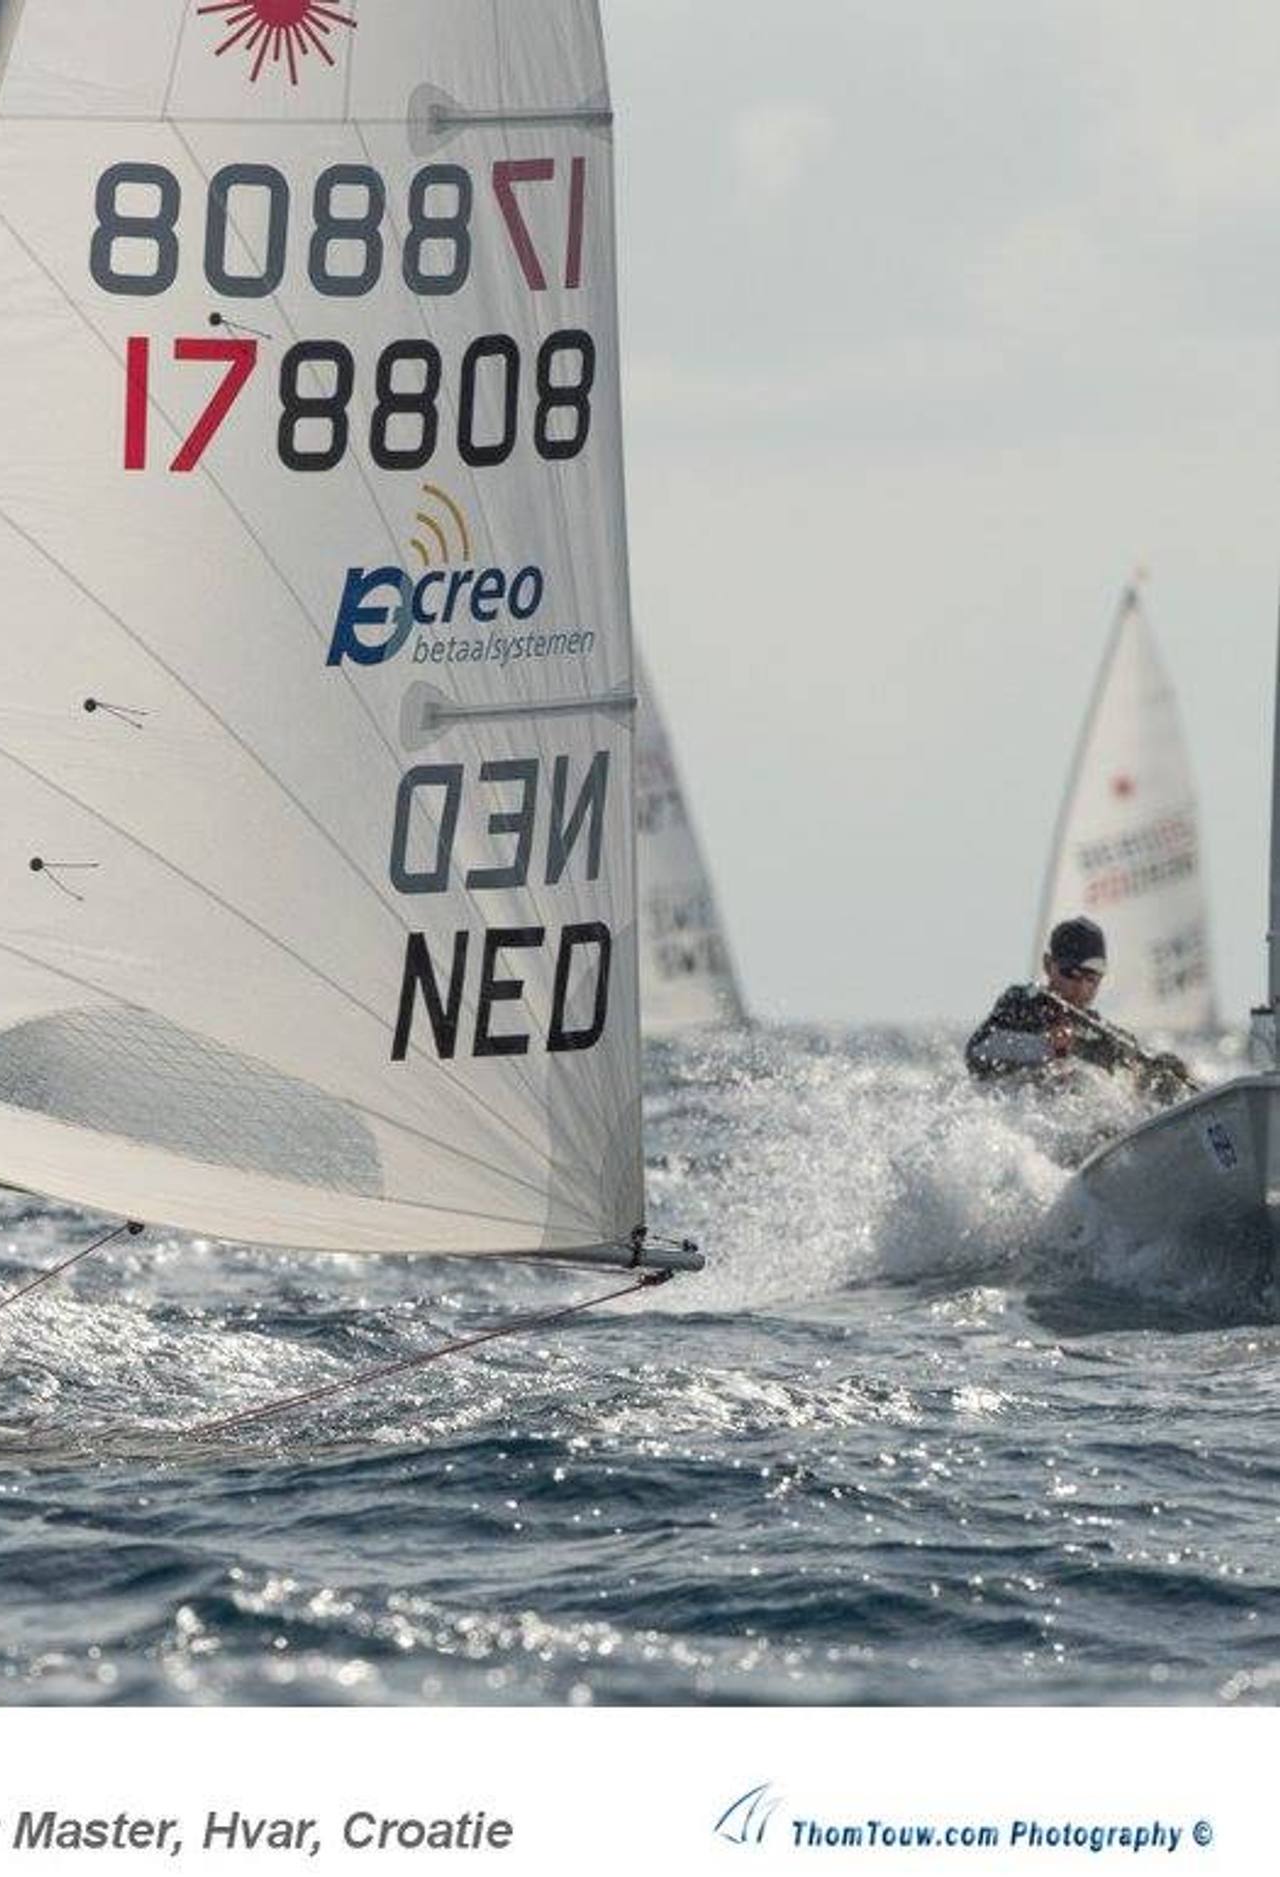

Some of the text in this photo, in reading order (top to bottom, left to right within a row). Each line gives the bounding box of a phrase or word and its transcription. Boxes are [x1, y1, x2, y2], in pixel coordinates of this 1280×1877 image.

[123, 328, 596, 471] 178808
[411, 628, 595, 667] betaalsystemen
[390, 921, 613, 1061] NED
